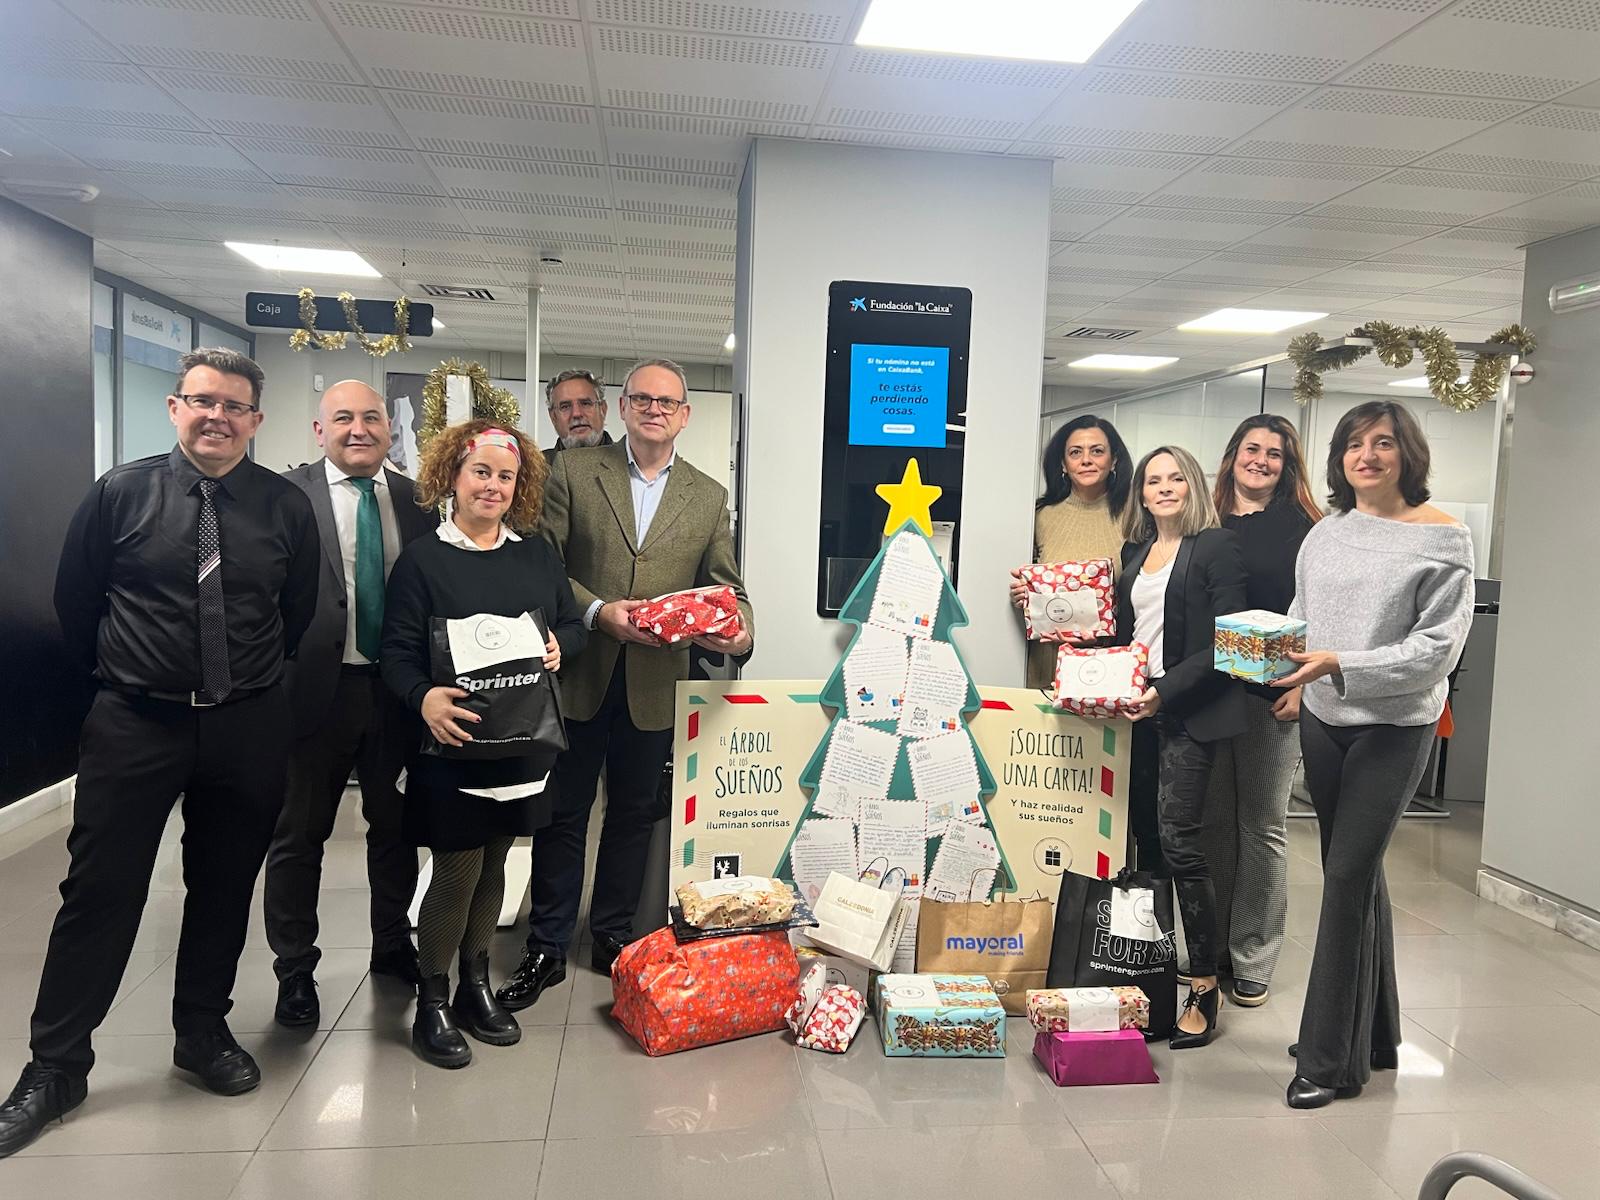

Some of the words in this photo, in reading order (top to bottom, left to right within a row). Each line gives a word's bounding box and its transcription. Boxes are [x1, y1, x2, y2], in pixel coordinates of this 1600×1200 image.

[256, 302, 281, 315] Caja
[870, 299, 914, 311] Fundación
[879, 383, 890, 392] te
[893, 383, 923, 393] estás
[870, 394, 928, 405] perdiendo
[883, 406, 916, 416] cosas.
[455, 672, 541, 693] Sprinter
[719, 736, 726, 746] EL
[729, 727, 772, 755] ÁRBOL
[1010, 728, 1084, 759] ¡SOLICITA
[728, 758, 736, 767] DE
[738, 757, 749, 767] LOS
[715, 764, 783, 799] SUEÑOS
[1003, 762, 1038, 788] UNA
[1044, 766, 1093, 794] CARTA!
[1010, 799, 1018, 807] Y
[1020, 801, 1038, 810] haz
[1041, 803, 1084, 814] realidad
[718, 809, 758, 819] Regalos
[760, 809, 779, 818] que
[1018, 813, 1035, 821] sus
[1038, 814, 1074, 825] sueños
[706, 821, 748, 830] iluminan
[751, 819, 790, 829] sonrisas
[947, 933, 1024, 954] mayoral
